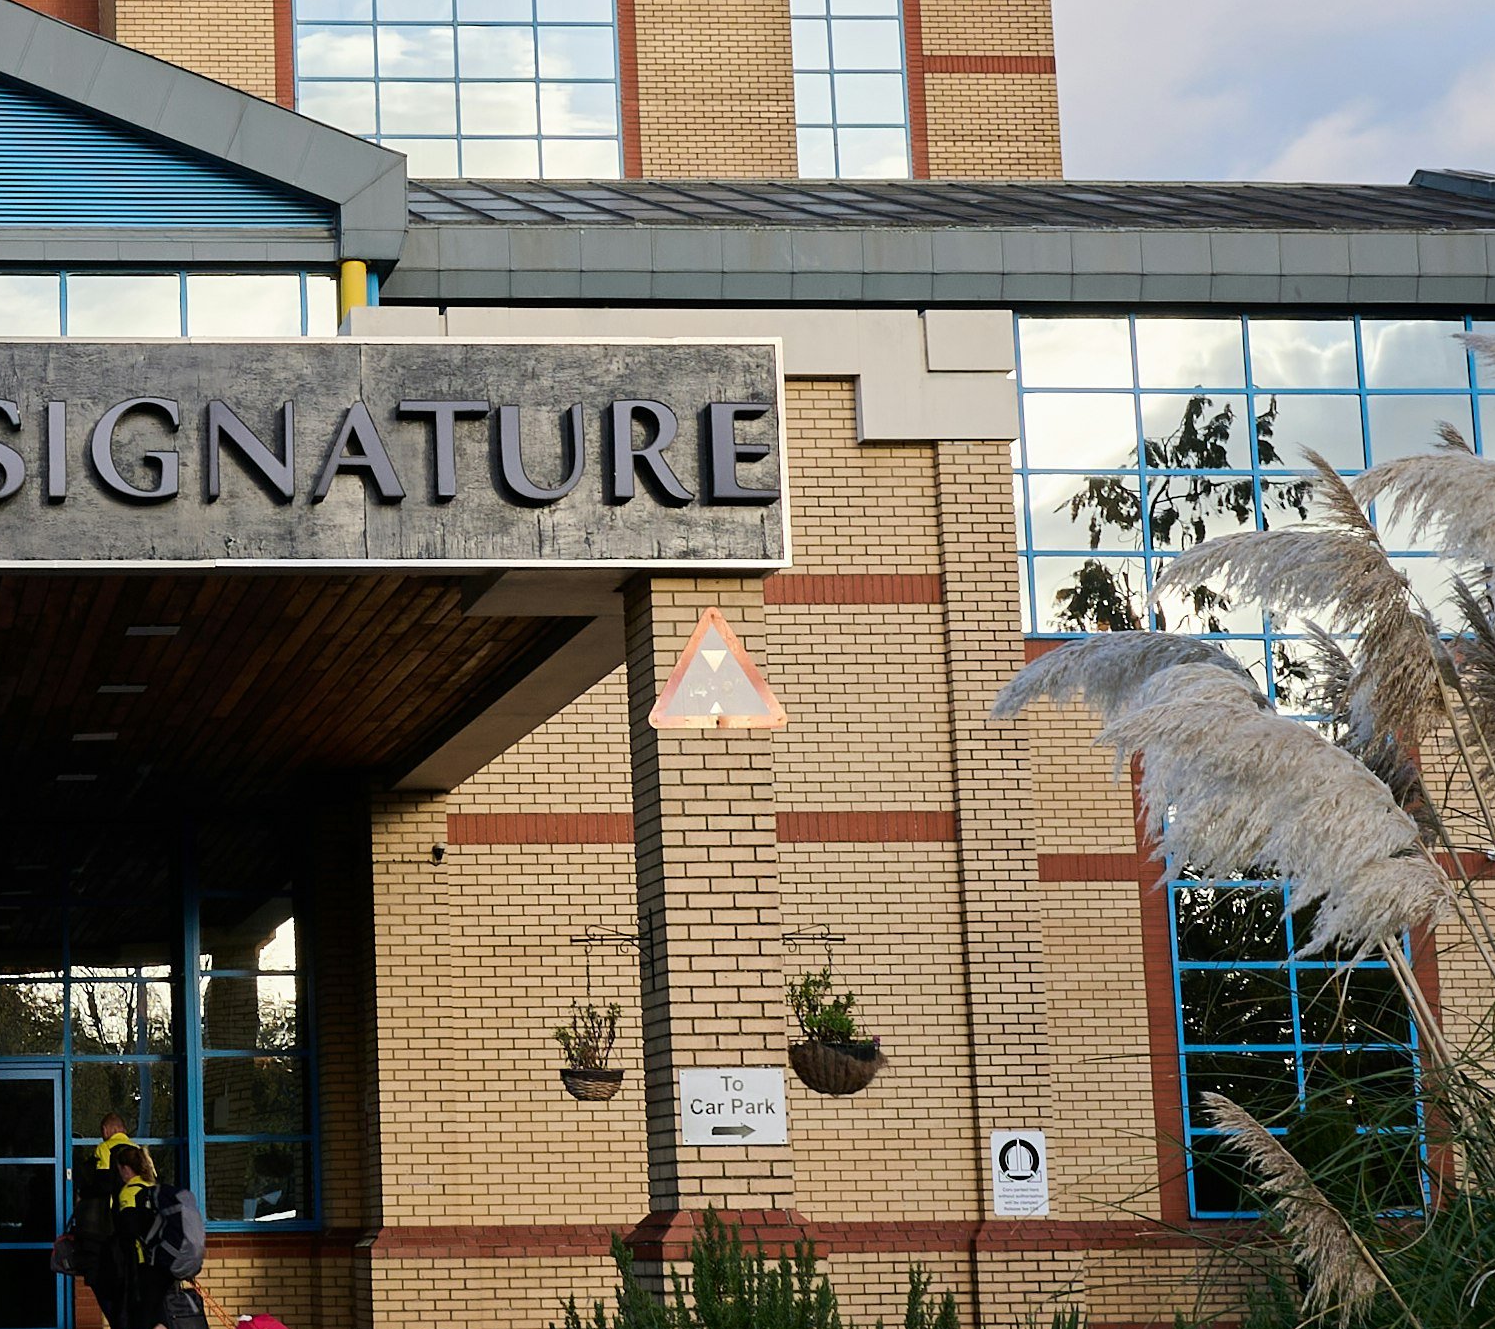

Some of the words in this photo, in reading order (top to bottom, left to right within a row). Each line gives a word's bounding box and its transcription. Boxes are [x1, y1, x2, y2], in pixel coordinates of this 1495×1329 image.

[720, 1075, 744, 1092] To
[690, 1098, 725, 1115] Car
[731, 1098, 776, 1115] Park
